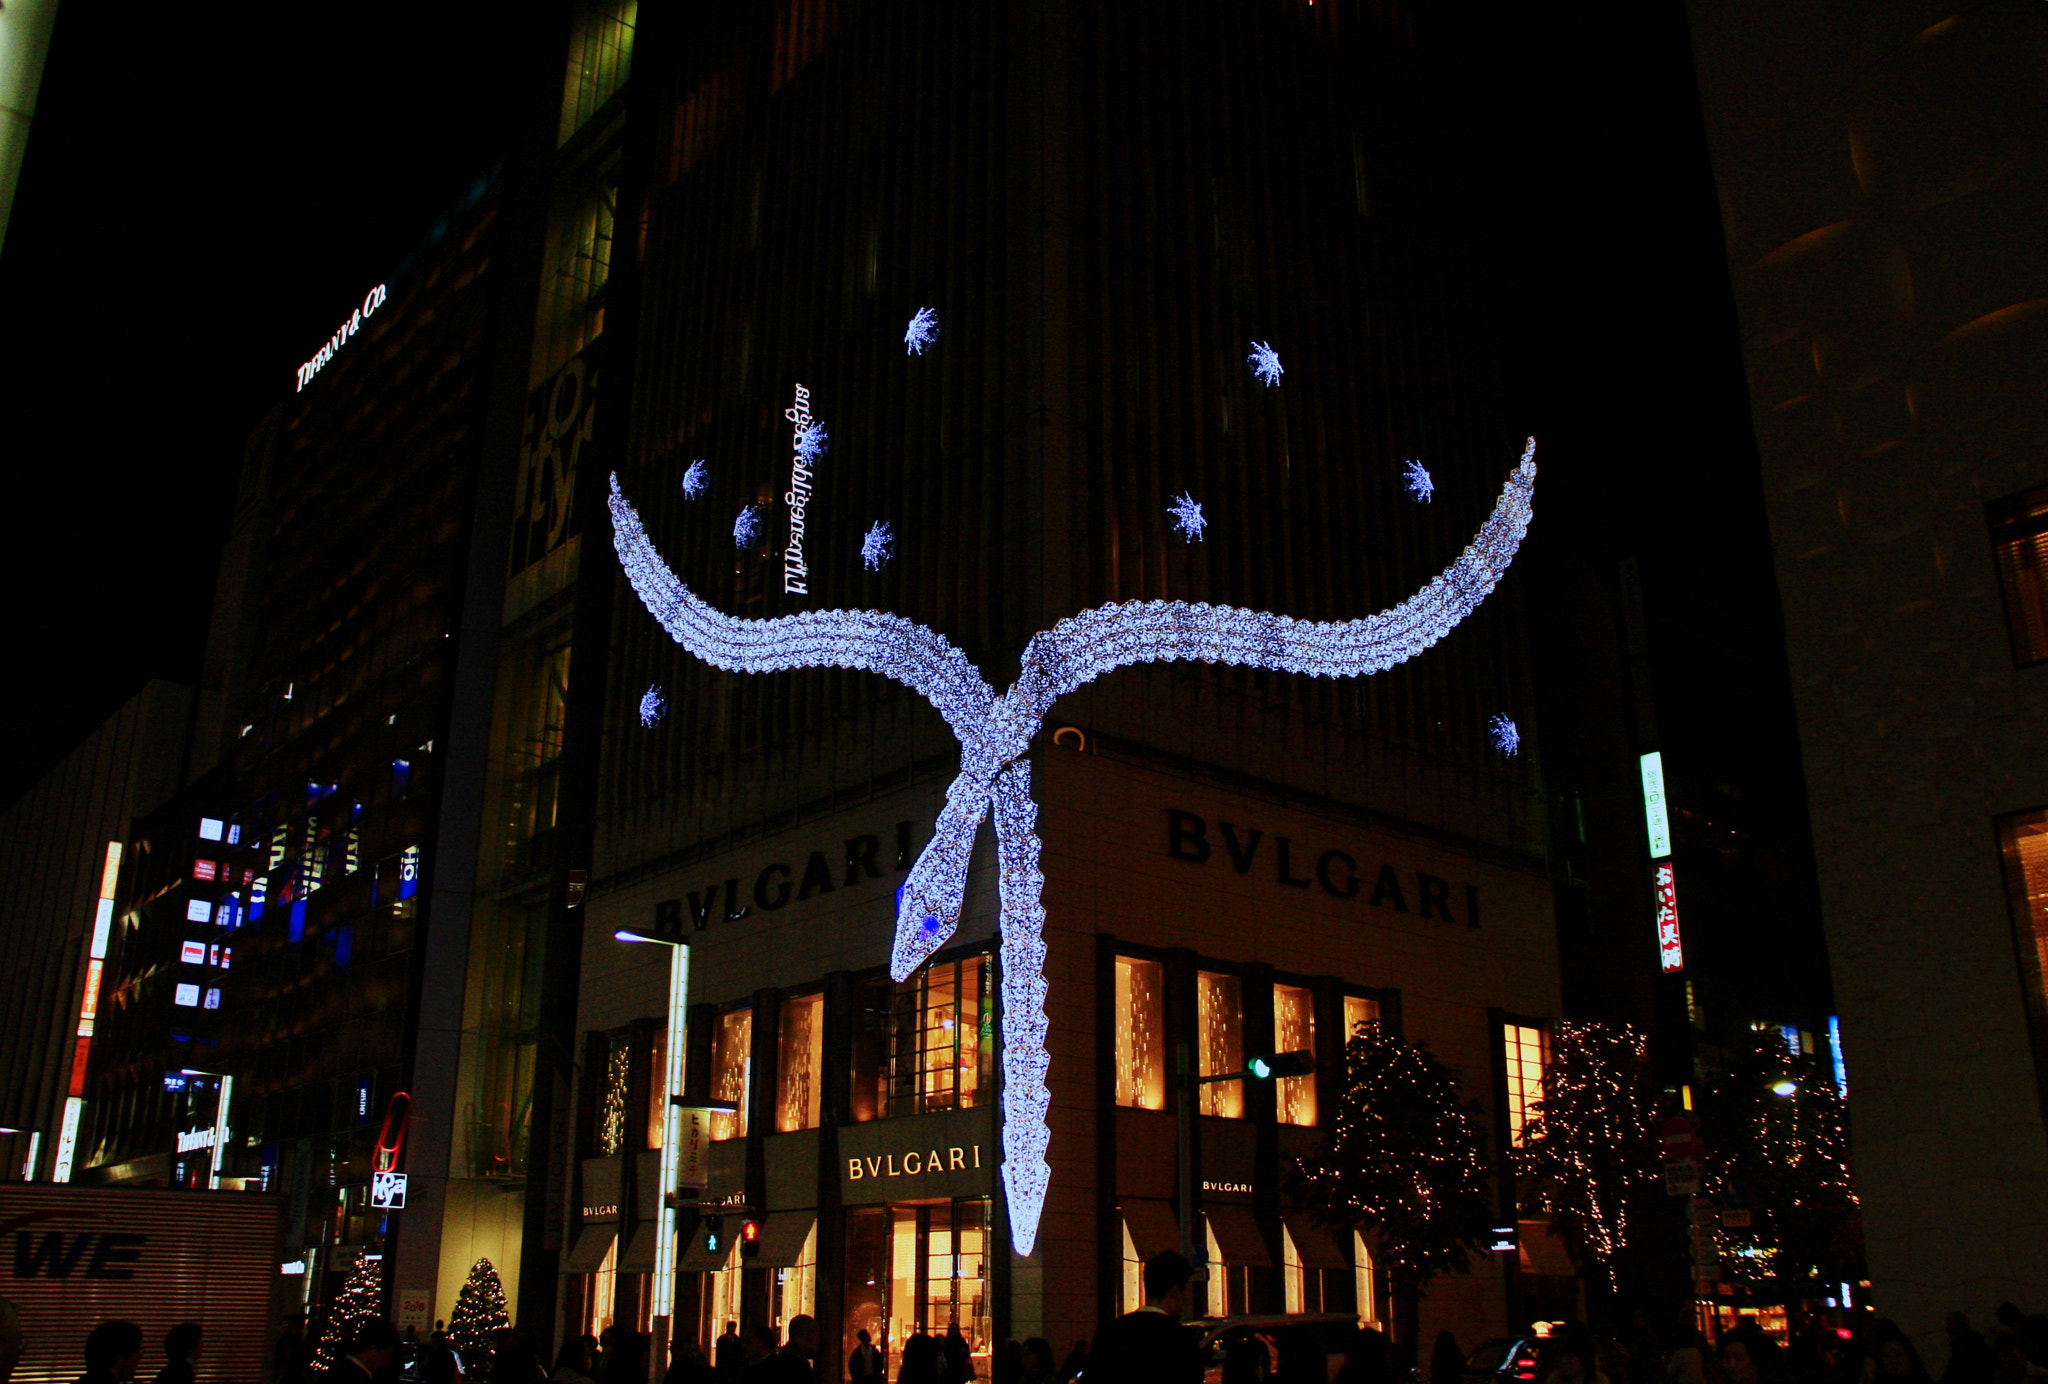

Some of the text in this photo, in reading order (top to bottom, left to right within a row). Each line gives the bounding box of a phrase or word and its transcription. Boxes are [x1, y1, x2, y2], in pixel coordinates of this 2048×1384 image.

[297, 320, 350, 392] TIFFANY
[348, 308, 361, 336] &
[655, 821, 912, 937] BVLGARI
[1167, 808, 1481, 929] BVLGARI
[848, 1145, 981, 1180] BVLGARI
[583, 1205, 618, 1217] BVLGAR
[1202, 1181, 1253, 1193] BVLGARI
[14, 1231, 150, 1279] WE
